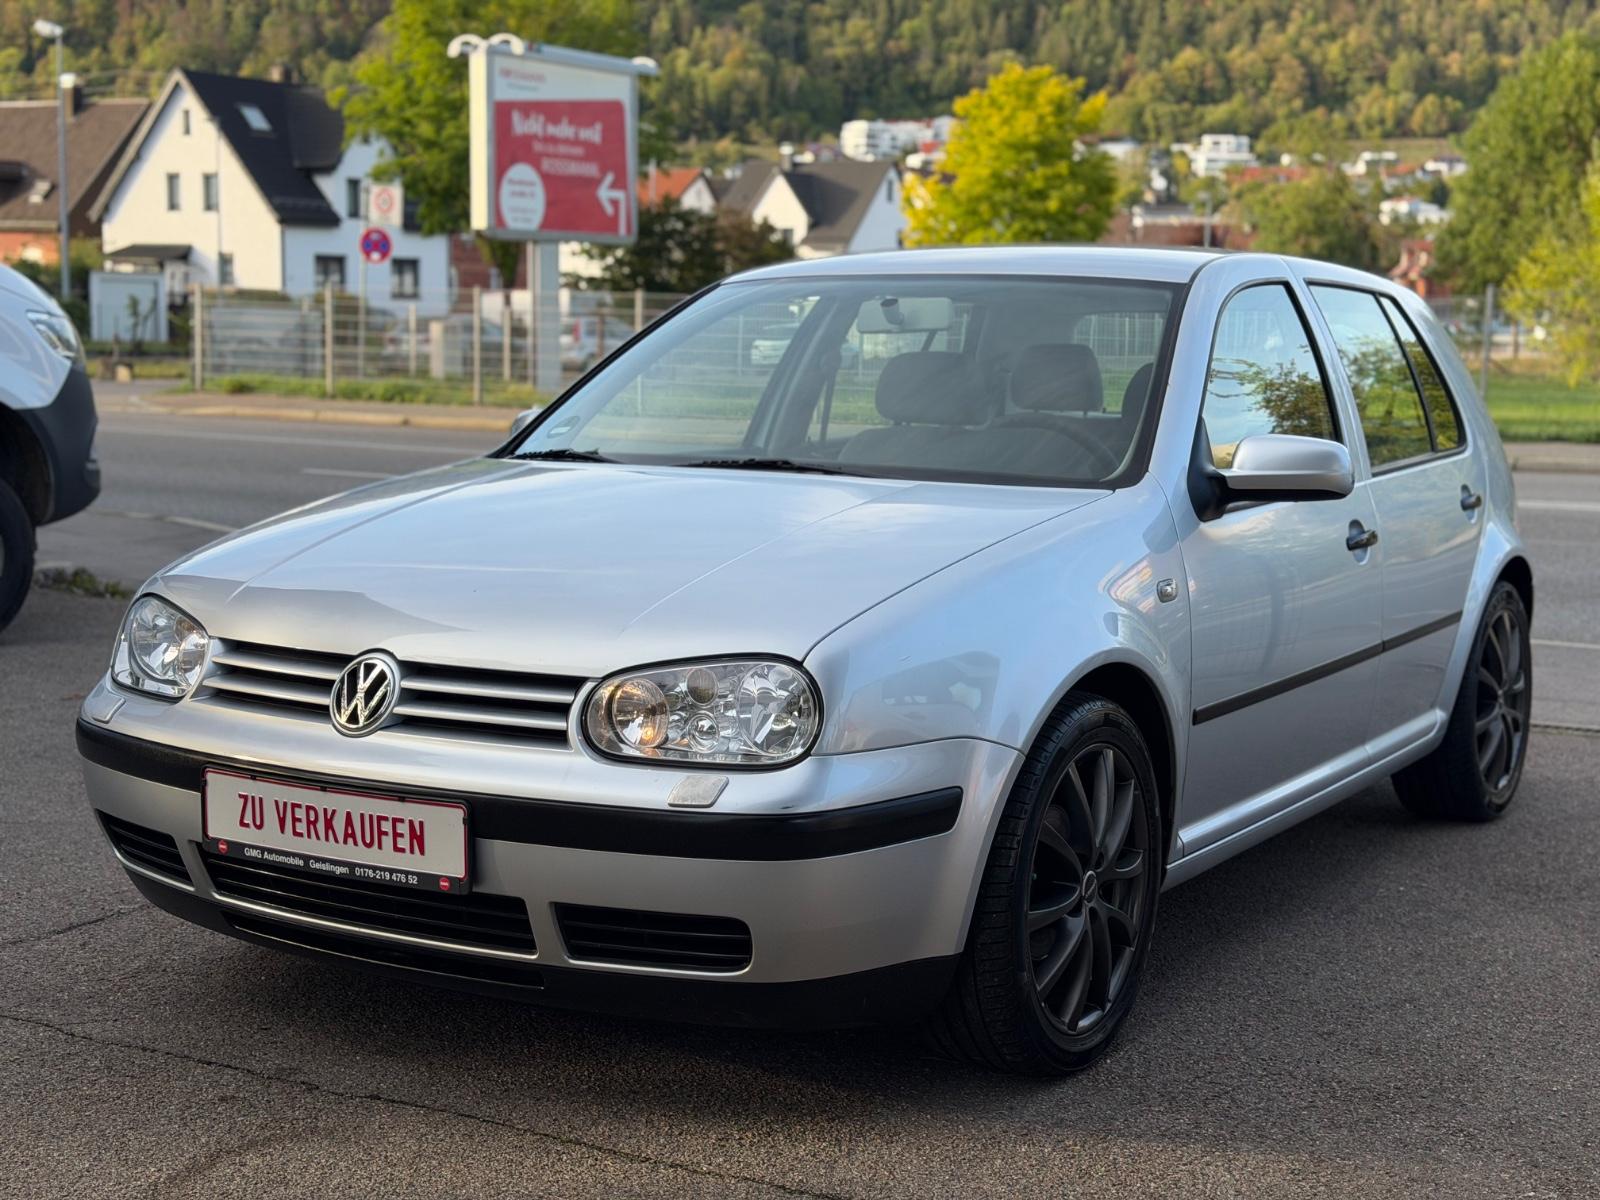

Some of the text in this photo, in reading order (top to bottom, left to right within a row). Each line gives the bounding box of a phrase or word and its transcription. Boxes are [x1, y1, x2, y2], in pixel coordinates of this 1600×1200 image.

[333, 656, 395, 731] VW
[238, 792, 426, 857] ZU VERKAUFEN
[244, 847, 418, 885] GMG Automobile Geislingen 0176-219 476 52
